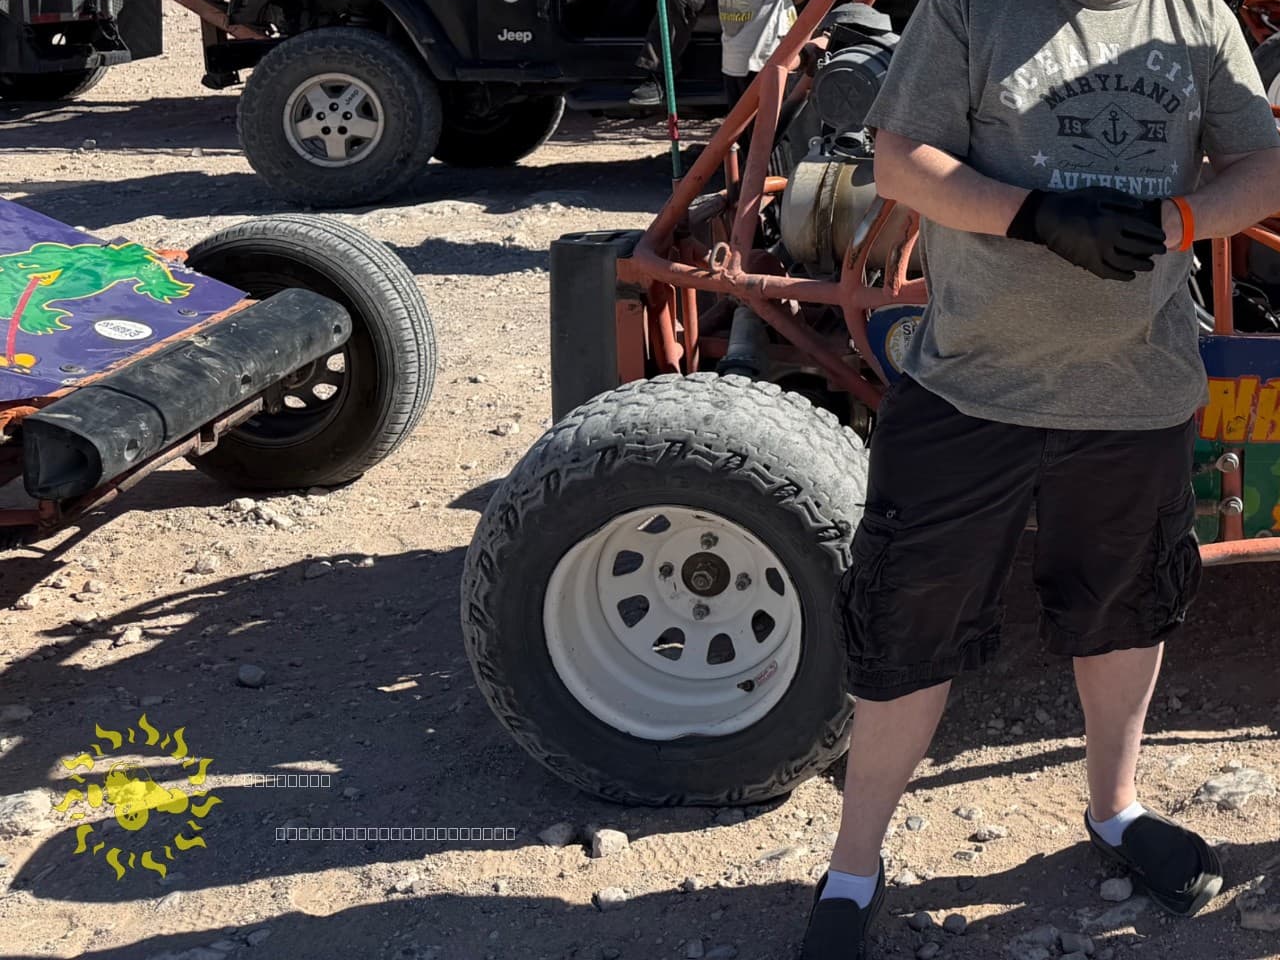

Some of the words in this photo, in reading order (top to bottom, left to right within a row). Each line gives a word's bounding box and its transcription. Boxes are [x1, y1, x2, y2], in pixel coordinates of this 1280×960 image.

[497, 28, 532, 42] Jeep
[1000, 42, 1121, 110] OCEAN
[1043, 73, 1182, 114] MARYLAND
[1147, 122, 1164, 137] 75
[1048, 169, 1172, 195] AUTHENTIC
